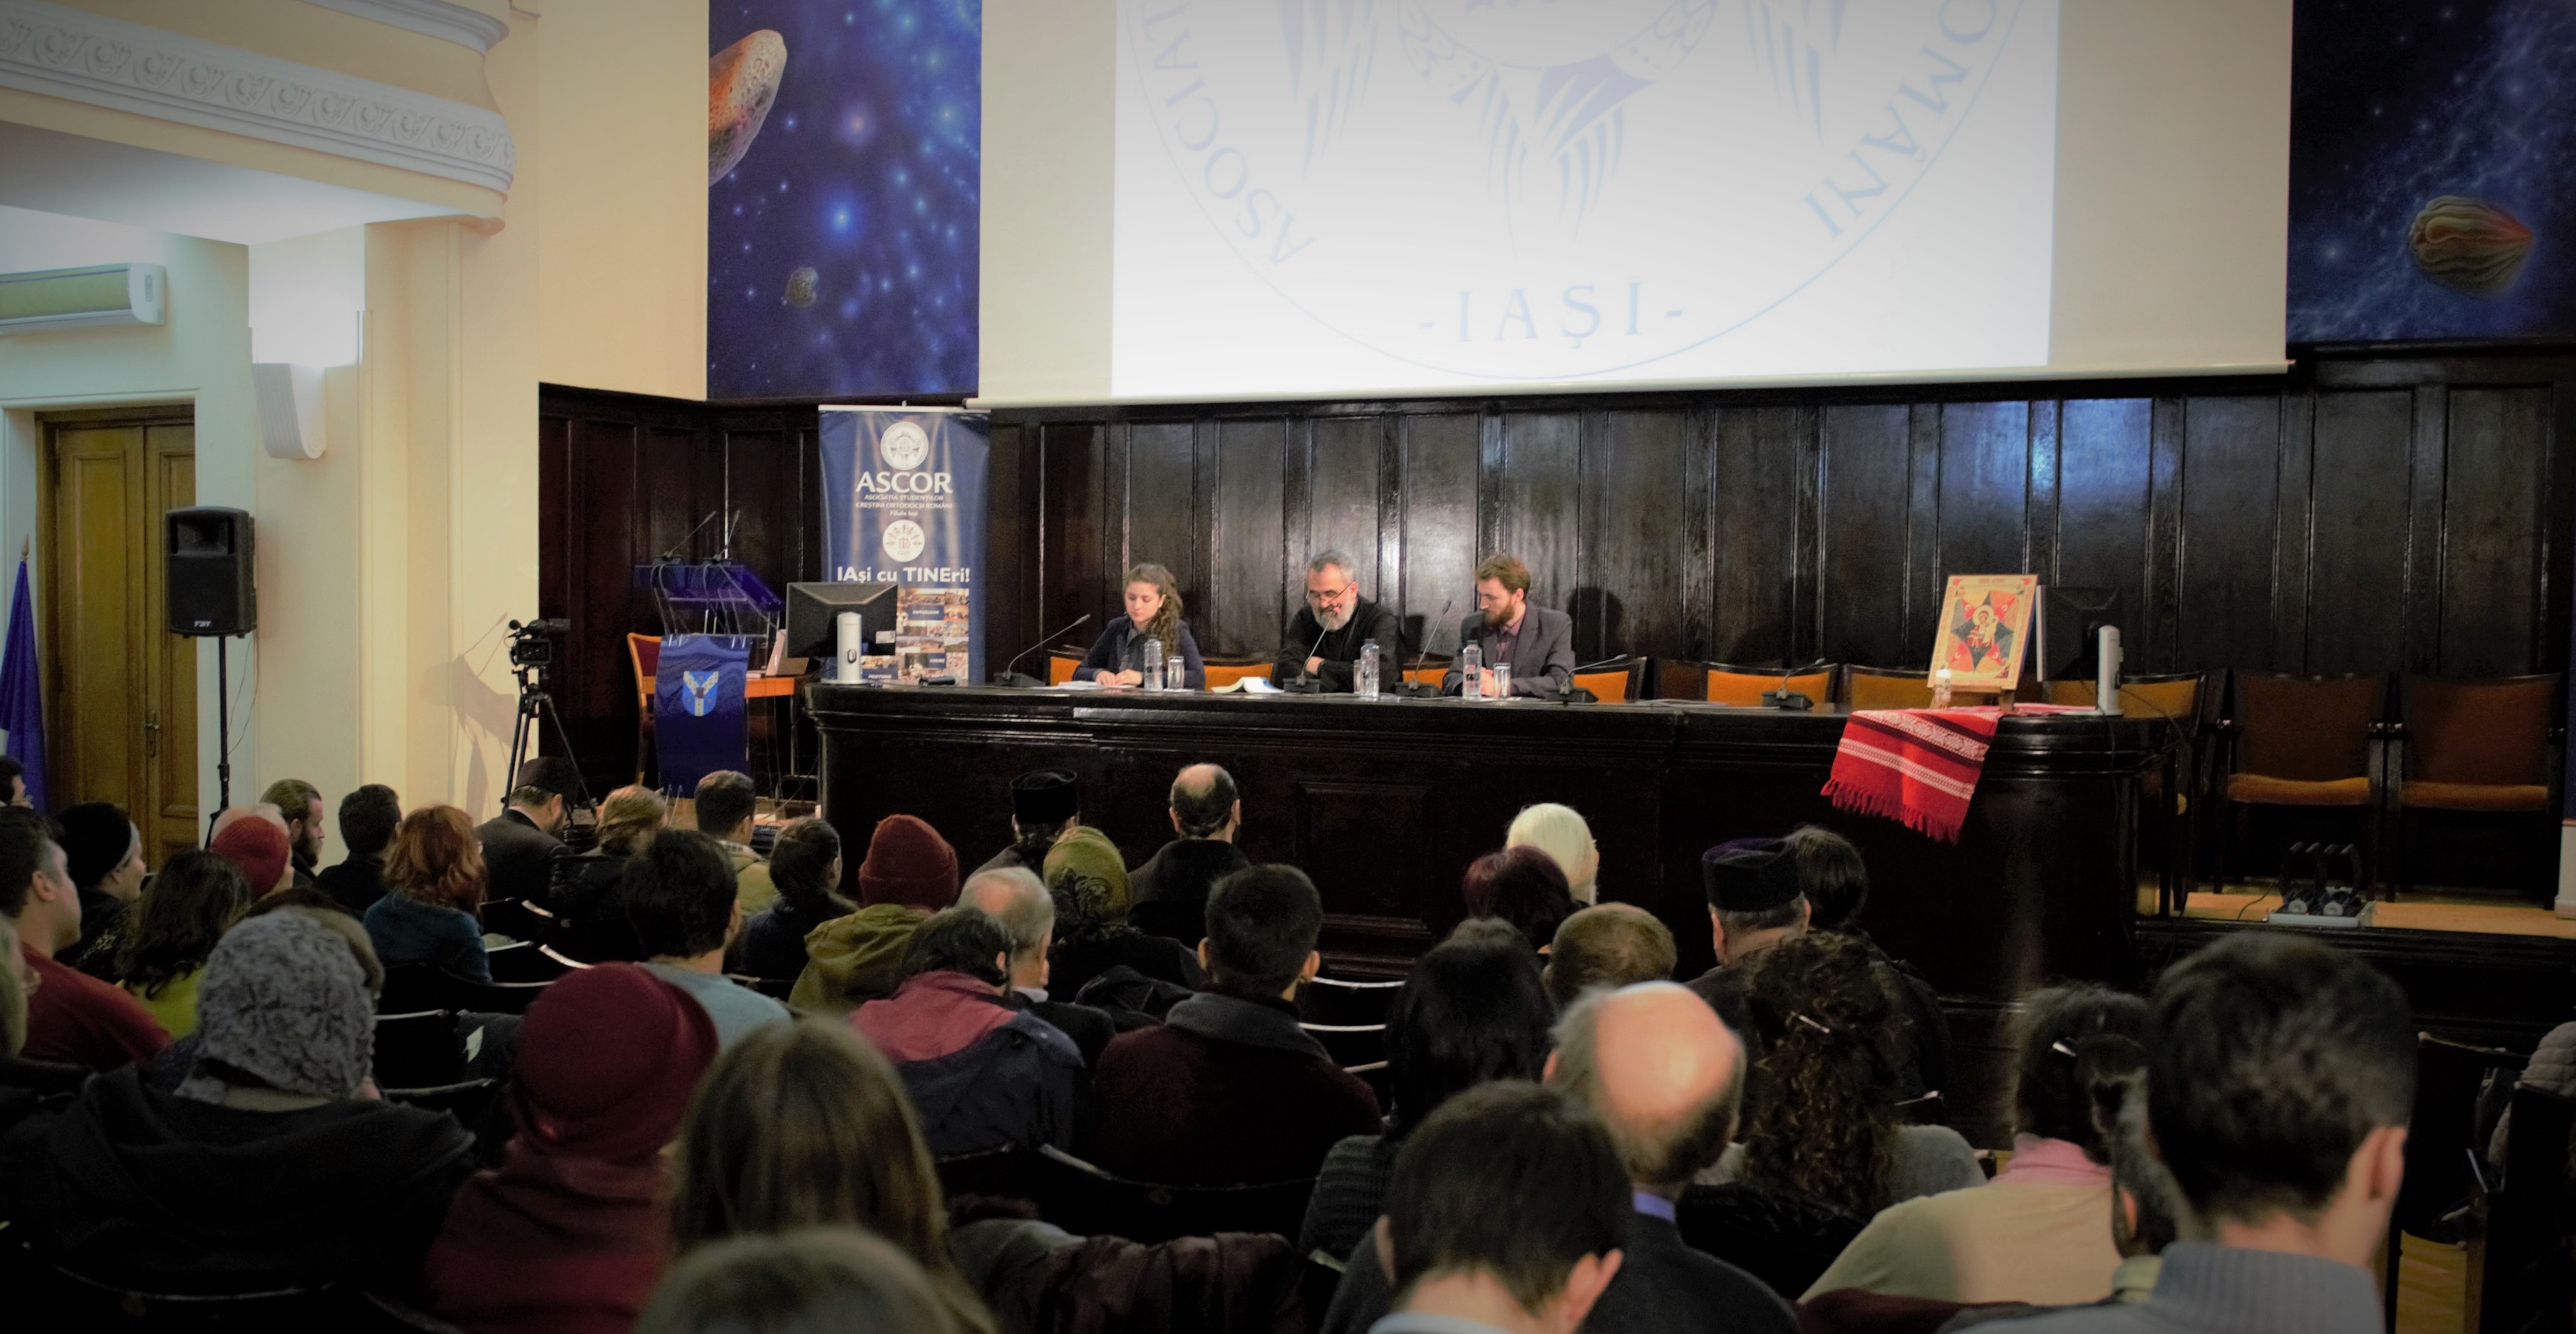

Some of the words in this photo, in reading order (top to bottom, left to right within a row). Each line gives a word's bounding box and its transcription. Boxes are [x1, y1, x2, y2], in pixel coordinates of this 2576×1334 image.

[855, 471, 954, 494] ASCOR
[837, 566, 871, 584] IAși
[877, 571, 897, 582] cu
[903, 567, 970, 582] TINEri!
